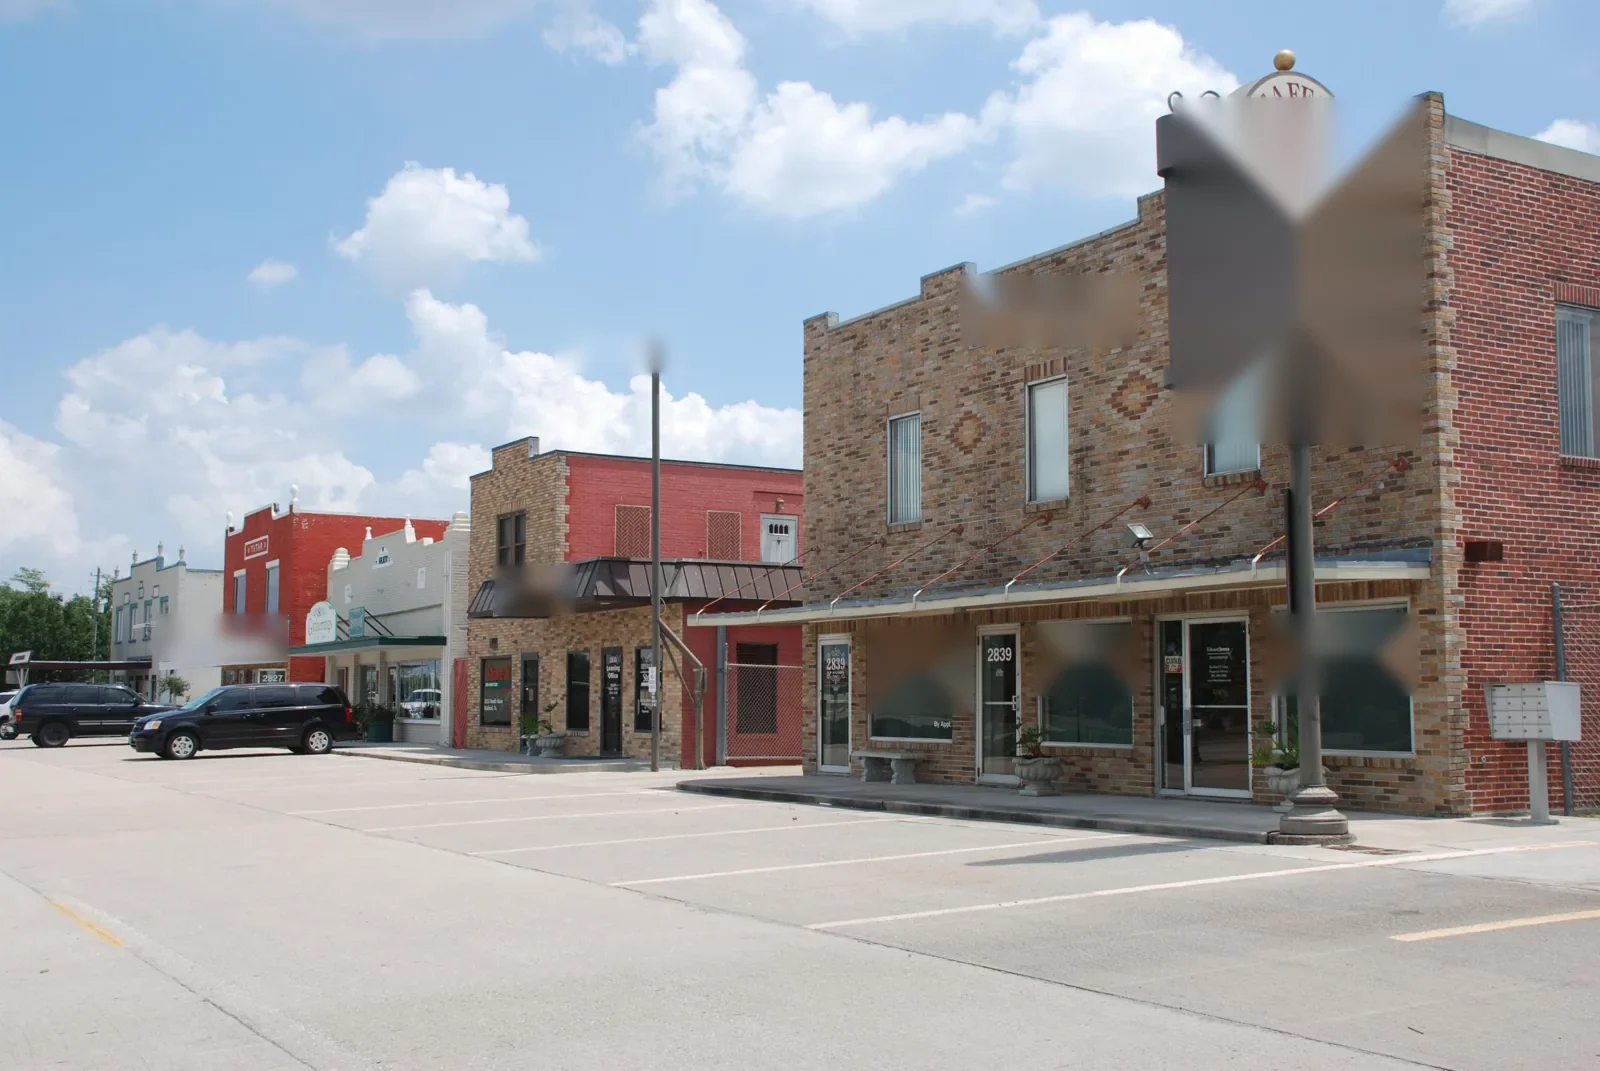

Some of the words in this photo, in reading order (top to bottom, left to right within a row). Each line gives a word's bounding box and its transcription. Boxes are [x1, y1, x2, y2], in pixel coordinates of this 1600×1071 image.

[987, 647, 1012, 662] 2839
[826, 658, 846, 671] 2839
[262, 674, 283, 682] 2827
